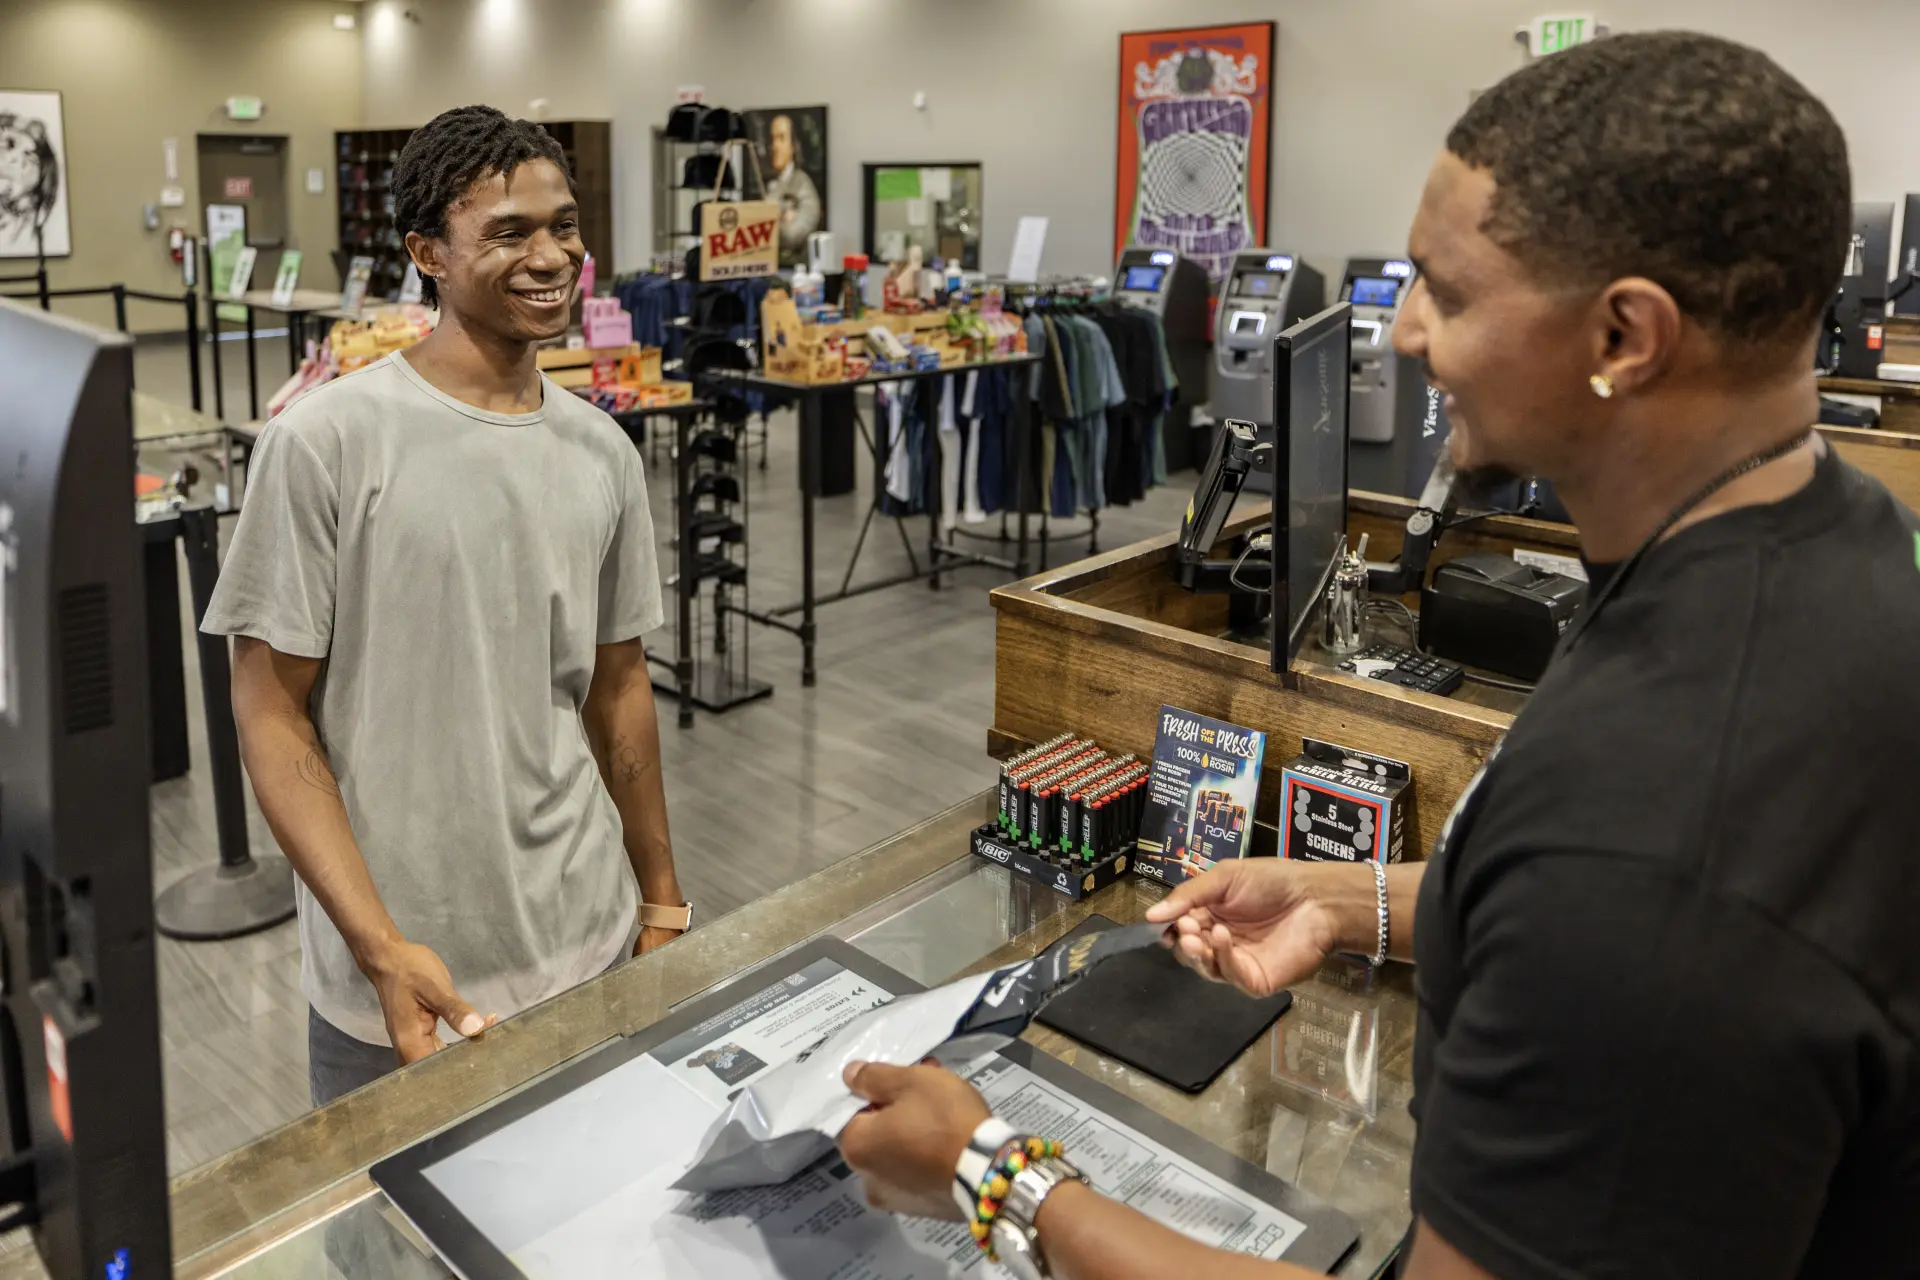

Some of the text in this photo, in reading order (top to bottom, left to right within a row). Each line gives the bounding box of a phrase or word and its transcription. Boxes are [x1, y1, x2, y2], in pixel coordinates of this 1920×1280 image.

[1541, 19, 1585, 54] EXIT
[708, 219, 775, 259] RAW
[1423, 384, 1440, 438] ViewS
[1163, 714, 1258, 760] FRESH OFF THE PRESS
[1176, 746, 1235, 775] 100% ROSIN
[1156, 772, 1192, 788] FULL SPECTRUM
[1294, 764, 1387, 794] SCREEN FILTERS
[1354, 776, 1379, 785] Steel
[1155, 780, 1168, 788] TRUE
[1174, 786, 1189, 796] PLANT
[1154, 792, 1186, 808] LIMITED SMALL
[1328, 804, 1337, 820] 5
[1312, 812, 1354, 832] Stainless Steel
[1204, 824, 1238, 842] ROVE
[984, 844, 1008, 861] BIC
[1306, 832, 1356, 860] SCREENS
[1014, 862, 1032, 874] bic.com
[1140, 862, 1164, 878] ROVE
[764, 1002, 774, 1010] do
[773, 993, 790, 1004] How
[824, 996, 850, 1012] Extras
[744, 1008, 760, 1020] sign
[730, 1018, 743, 1029] up?
